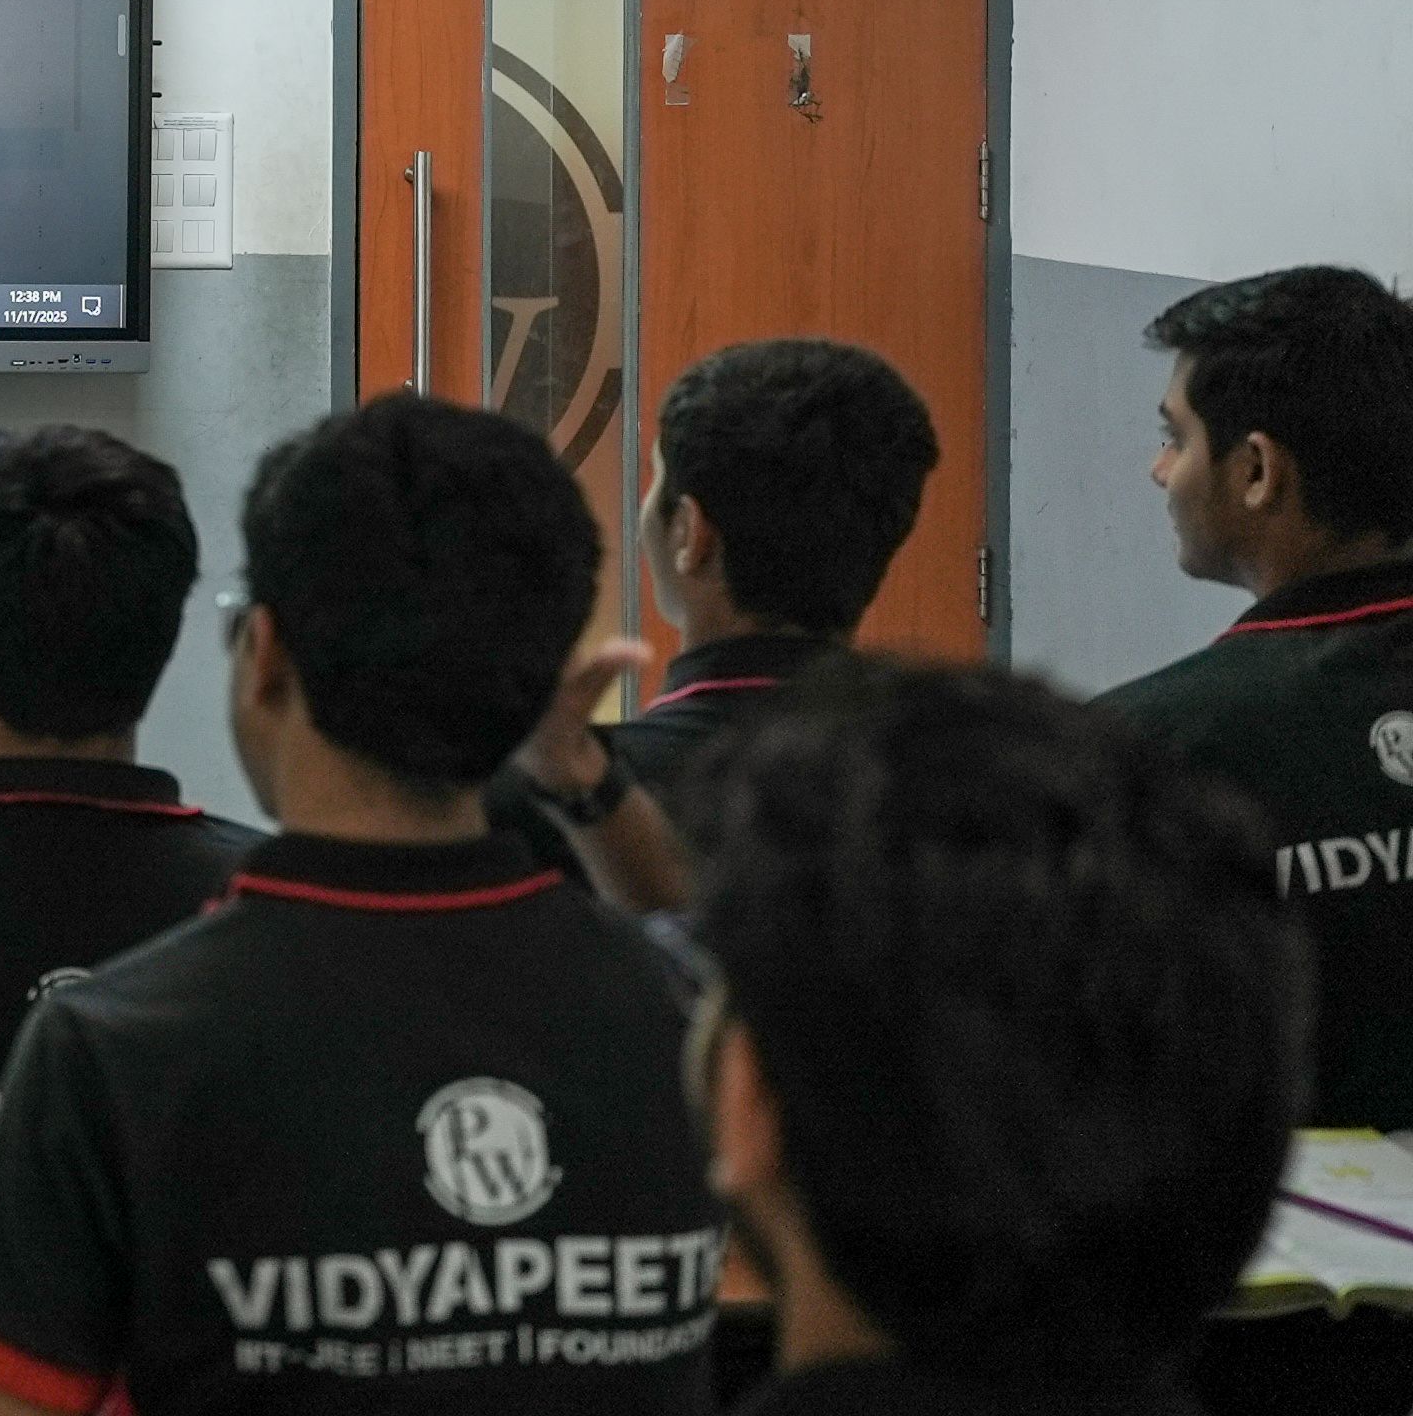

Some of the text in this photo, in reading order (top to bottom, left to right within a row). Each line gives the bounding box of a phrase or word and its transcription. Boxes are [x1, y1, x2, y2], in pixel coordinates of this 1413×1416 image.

[9, 290, 62, 303] 12:38 PM
[3, 310, 68, 324] 11/17/2025
